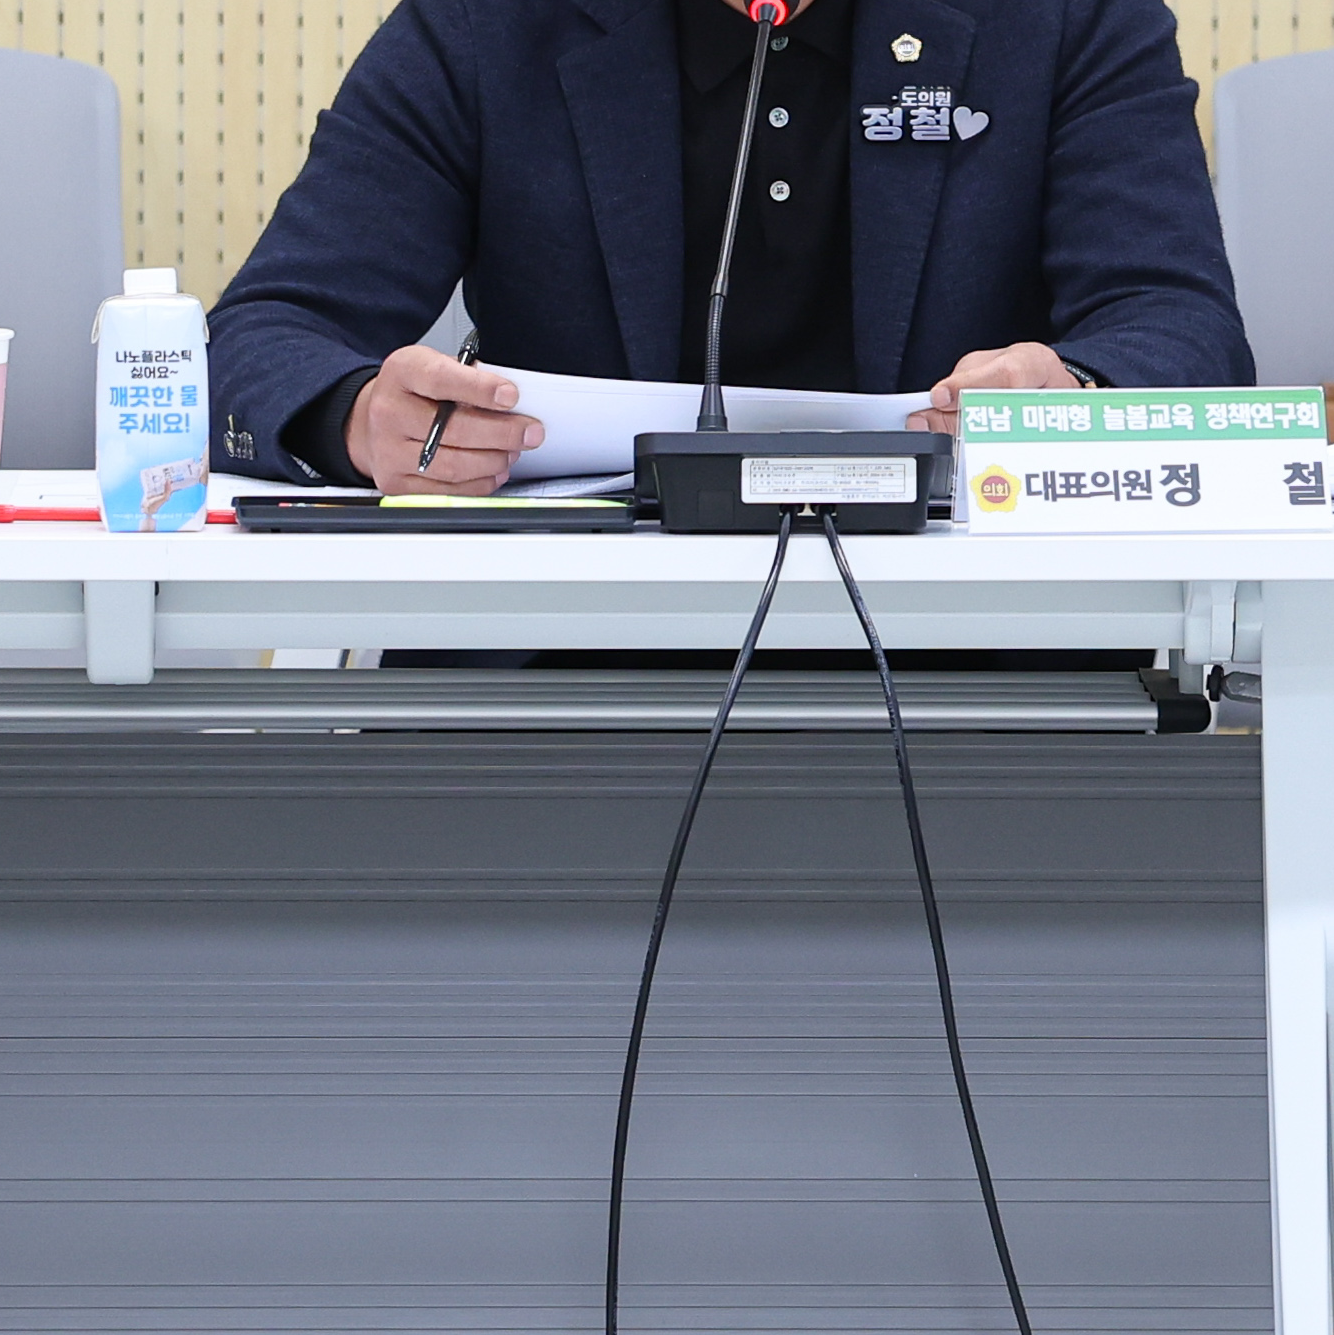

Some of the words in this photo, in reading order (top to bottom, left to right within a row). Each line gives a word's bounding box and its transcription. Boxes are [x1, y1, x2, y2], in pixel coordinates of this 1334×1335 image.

[901, 91, 951, 107] 도의원
[115, 350, 192, 364] 나노플라스틱
[109, 385, 174, 408] 깨끗한
[180, 385, 199, 407] 물
[118, 413, 190, 435] 주세요!
[965, 405, 1012, 433] 전남
[1021, 404, 1092, 432] 미래형
[1102, 403, 1195, 431] 늘봄교육
[1204, 402, 1320, 430] 정책연구회
[982, 483, 1010, 498] 의회
[1025, 469, 1154, 503] 대표의원
